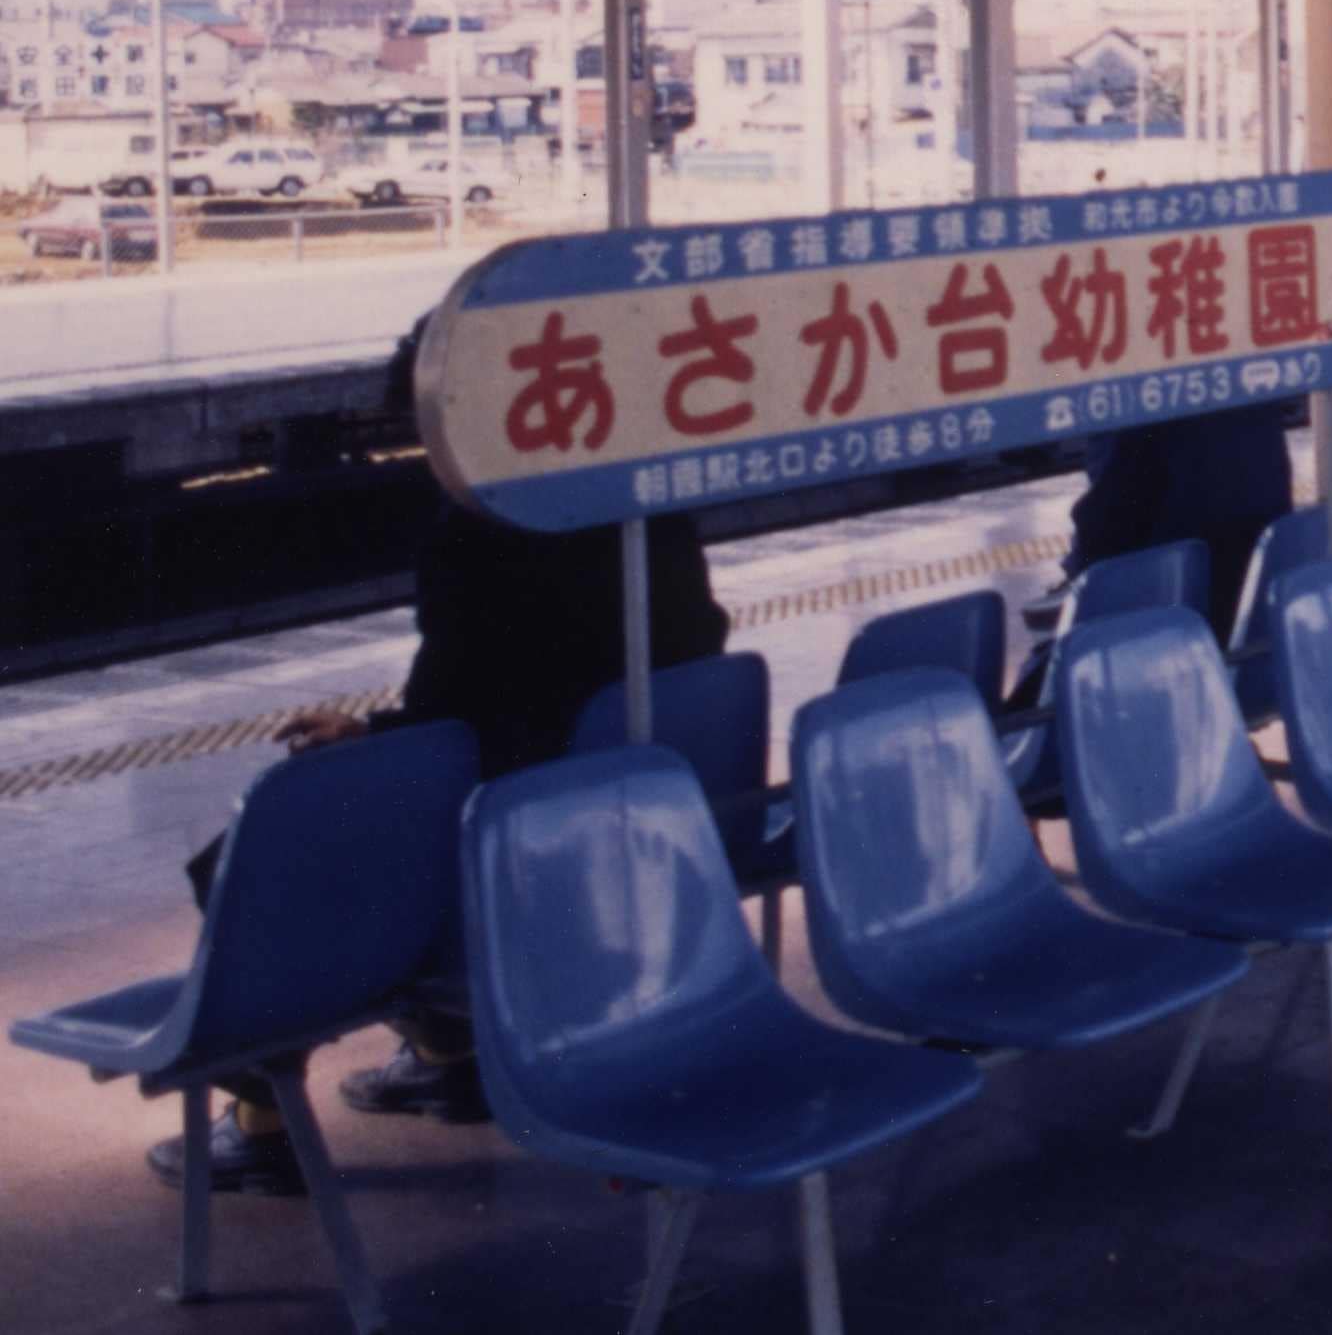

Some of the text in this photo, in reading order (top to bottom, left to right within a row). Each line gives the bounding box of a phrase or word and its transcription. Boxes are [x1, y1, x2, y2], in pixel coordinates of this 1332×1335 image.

[506, 226, 1320, 452] あさか台幼稚園
